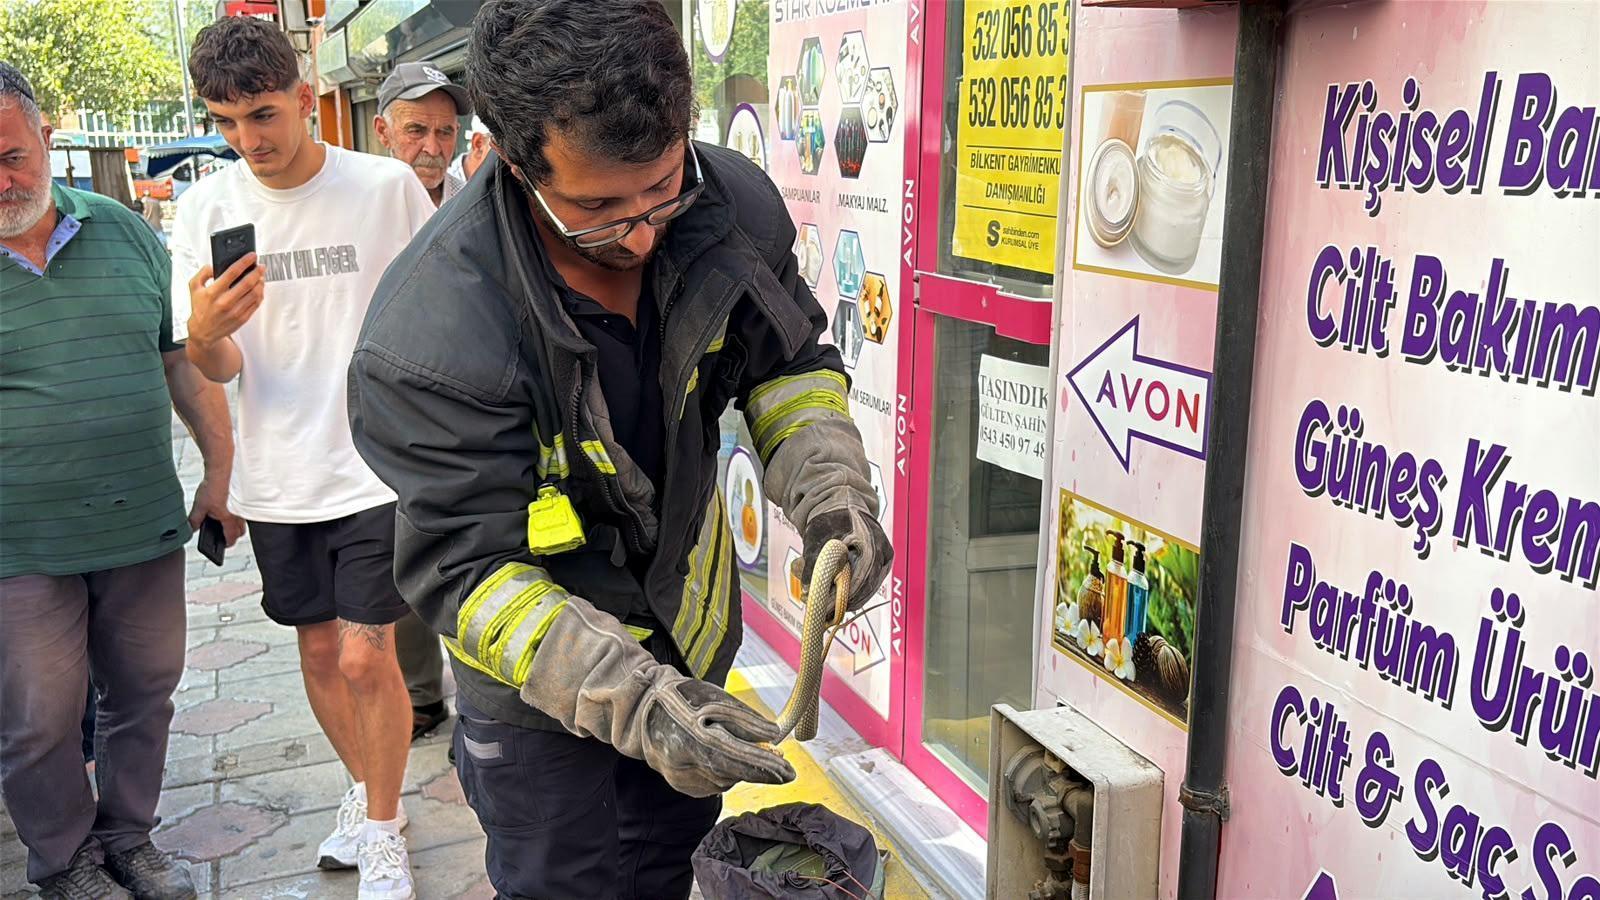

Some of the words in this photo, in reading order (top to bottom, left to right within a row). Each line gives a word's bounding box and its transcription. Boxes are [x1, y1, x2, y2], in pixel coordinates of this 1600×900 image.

[972, 9, 1000, 61] 532
[1001, 5, 1032, 59] 056
[1037, 2, 1059, 57] 85
[968, 77, 997, 128] 532
[1000, 76, 1031, 129] 056
[1033, 75, 1055, 129] 85
[970, 150, 1007, 171] BİLKENT
[1315, 70, 1501, 217] Kişisel
[838, 193, 865, 211] MAKYAJ
[903, 179, 914, 268] AVON
[985, 182, 1046, 205] DANIŞMANLIĞI
[293, 244, 360, 279] HILFIGER
[1306, 244, 1398, 359] Cilt
[1400, 253, 1600, 396] Bakım
[980, 374, 1048, 410] TAŞINDIK
[980, 402, 1013, 425] GÜLTEN
[1095, 369, 1201, 434] AVON
[897, 393, 906, 477] AVON
[999, 431, 1016, 451] 450
[1018, 436, 1031, 455] 97
[1294, 399, 1448, 560] Güneş
[892, 576, 902, 657] AVON
[1280, 542, 1460, 711] Parfüm
[1270, 685, 1352, 808] Cilt
[1355, 731, 1404, 828] &
[1404, 758, 1519, 900] Saç
